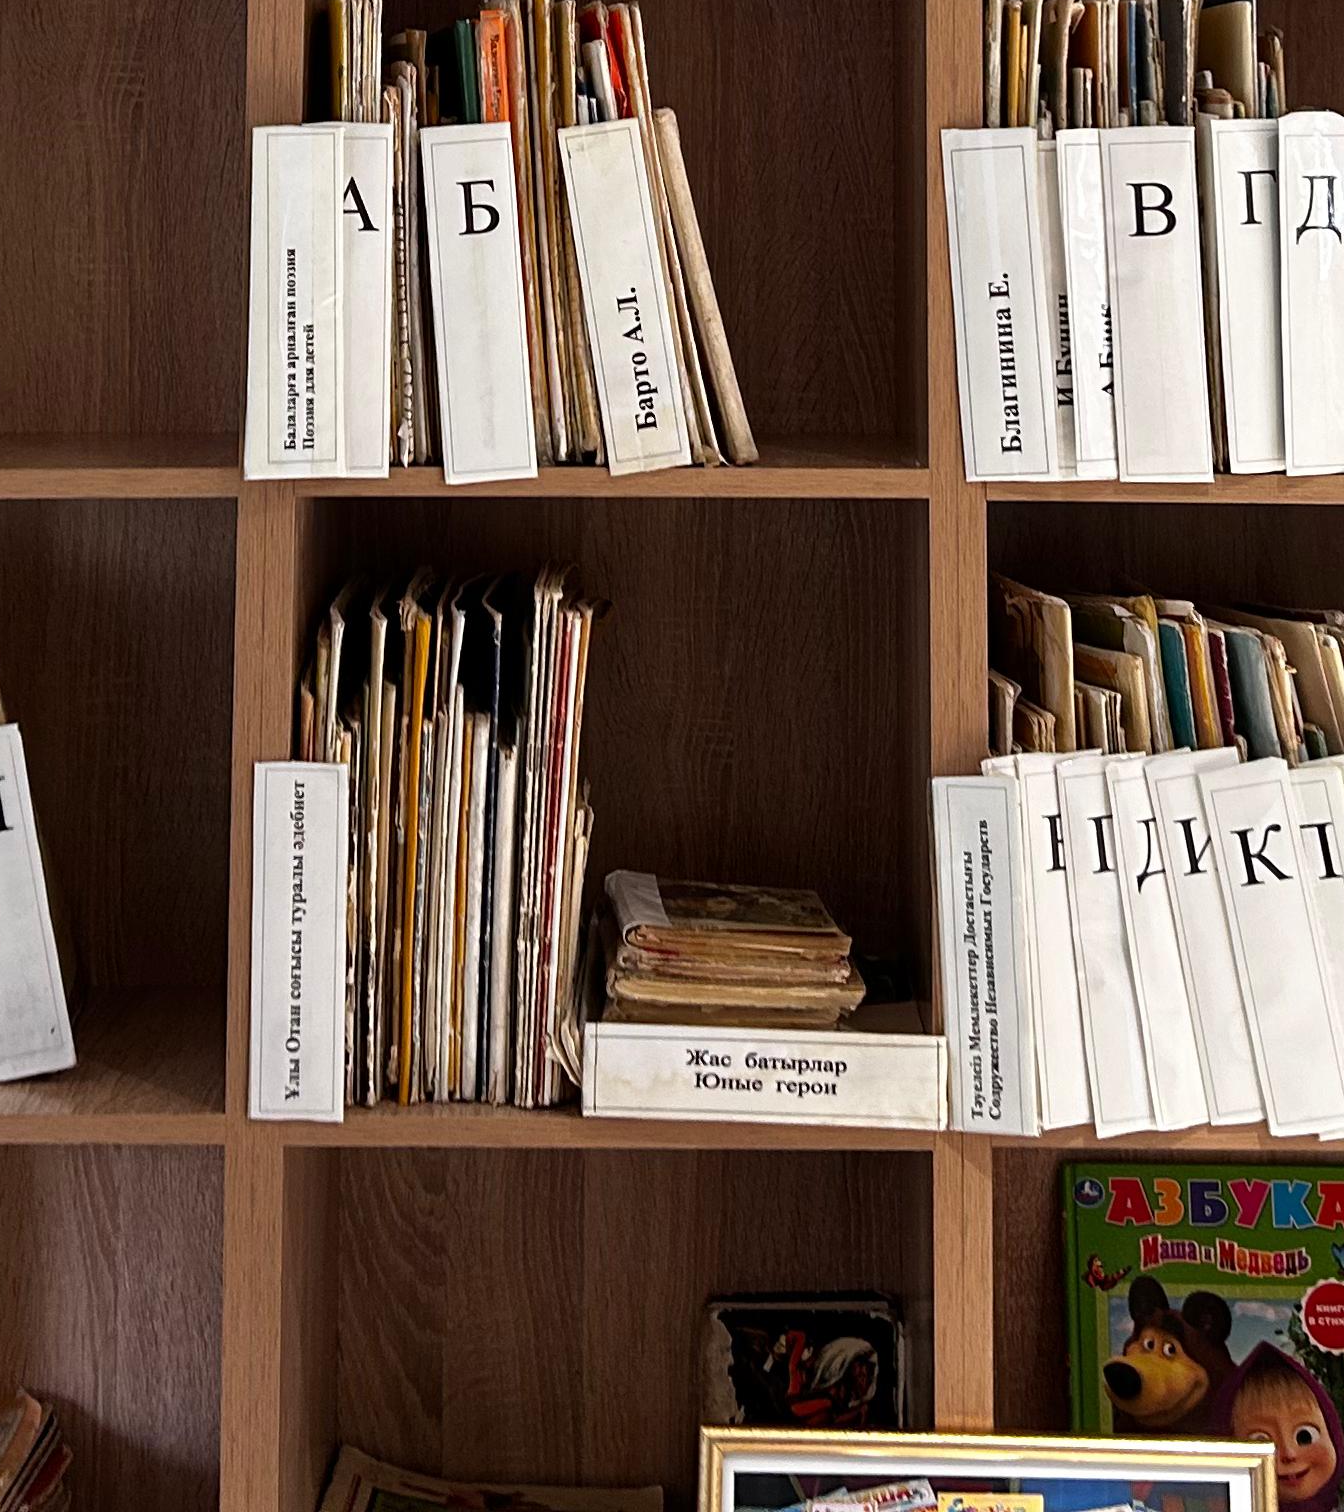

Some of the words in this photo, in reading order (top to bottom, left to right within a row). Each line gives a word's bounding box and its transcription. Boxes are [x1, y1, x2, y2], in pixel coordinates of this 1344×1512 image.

[342, 176, 380, 233] А
[456, 179, 501, 236] Б
[1126, 182, 1178, 239] В
[1236, 170, 1276, 226] Г
[1296, 175, 1343, 246] Д
[286, 248, 300, 310] поэзия
[989, 272, 1011, 300] Е.
[303, 323, 319, 363] детей
[616, 285, 644, 345] А.Л.
[303, 365, 318, 394] для
[631, 351, 659, 432] Барто
[997, 307, 1023, 455] Благинина
[302, 396, 316, 451] Поэзия
[291, 779, 306, 854] әдебиет
[977, 818, 994, 906] Государств
[1230, 823, 1294, 888] К
[290, 856, 309, 929] туралы
[982, 910, 999, 1015] Независимых
[285, 1000, 304, 1054] Отан
[965, 949, 983, 1052] Мемлекеттер
[686, 1049, 733, 1070] Жас
[744, 1051, 848, 1076] батырлар
[693, 1073, 765, 1094] Юные
[774, 1079, 839, 1098] герои
[985, 1018, 1003, 1121] Содружество
[1140, 1234, 1199, 1270] Маша
[1216, 1238, 1312, 1279] Медведь
